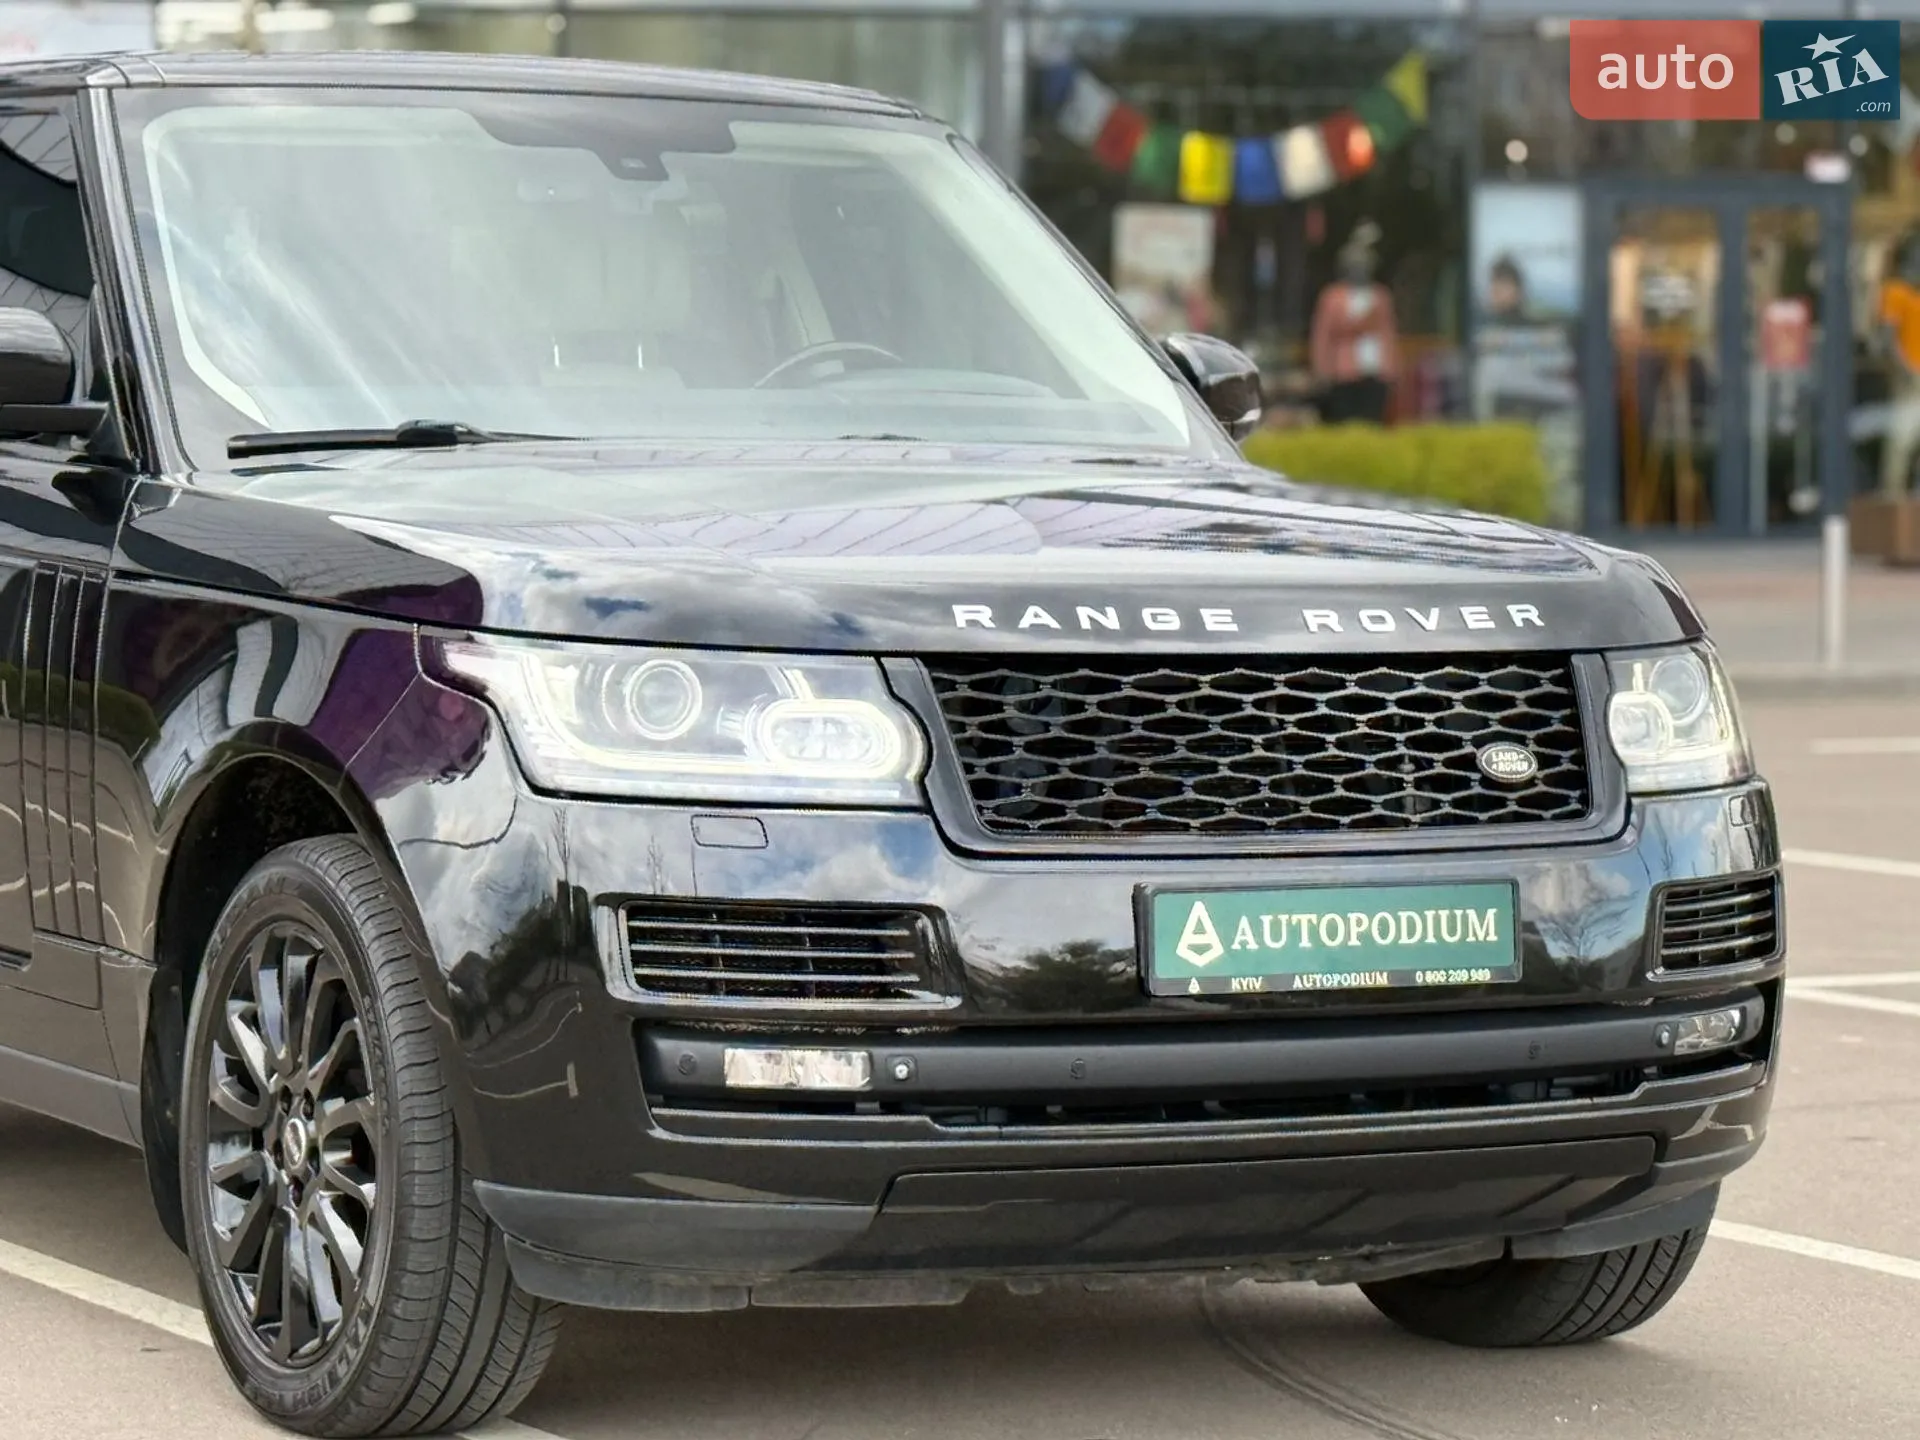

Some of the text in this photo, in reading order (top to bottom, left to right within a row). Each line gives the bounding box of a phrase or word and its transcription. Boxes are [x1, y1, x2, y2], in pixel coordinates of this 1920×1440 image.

[952, 603, 1545, 633] RANGE ROVER
[1230, 907, 1498, 951] AUTOPODIUM
[1231, 976, 1263, 991] KYIV
[1292, 971, 1389, 990] AUTOPODIUM
